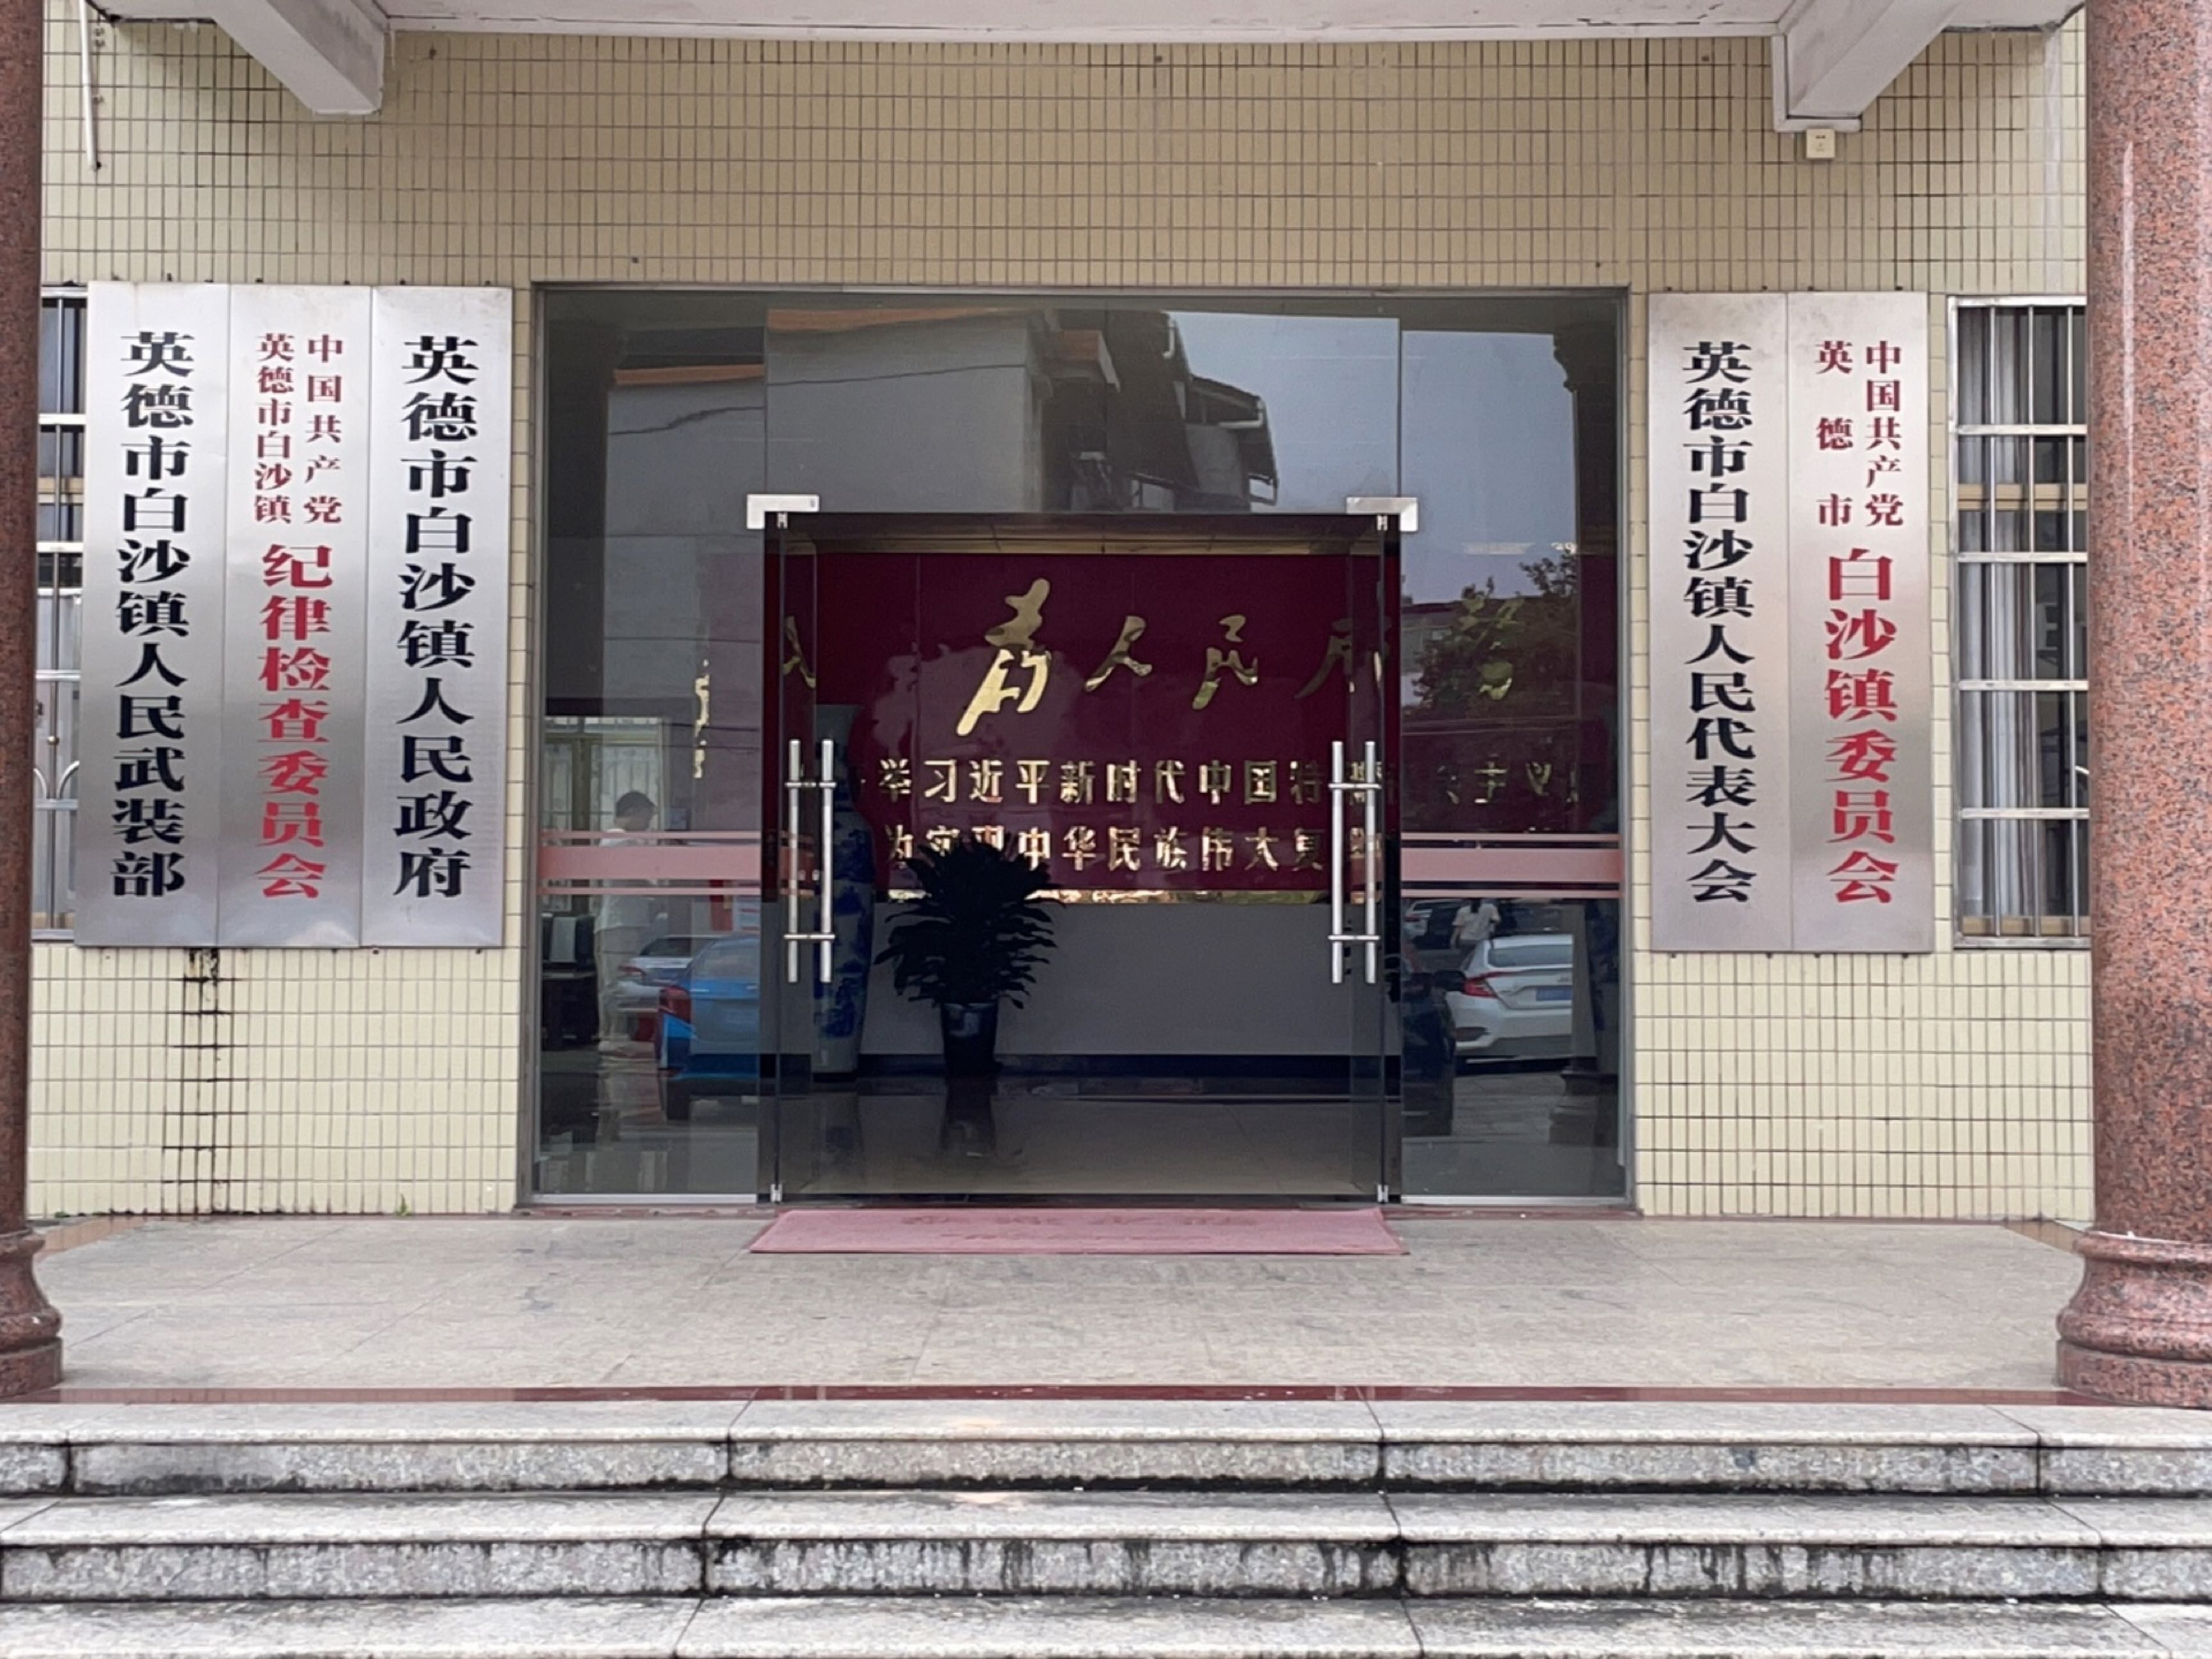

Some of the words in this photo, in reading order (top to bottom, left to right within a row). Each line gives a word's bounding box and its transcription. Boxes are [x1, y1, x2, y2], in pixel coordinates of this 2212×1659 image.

[254, 333, 295, 525] 英德市白沙镇
[304, 334, 344, 524] 中国共产党
[1816, 340, 1854, 527] 英德市
[1865, 340, 1905, 527] 中国共产党
[111, 330, 195, 898] 英德市白沙镇人民武装部
[256, 543, 334, 899] 纪律检查委员会
[393, 335, 479, 898] 英德市白沙镇人民政府
[1682, 341, 1758, 904] 英德市白沙镇人民代表大会
[1824, 547, 1899, 904] 白沙镇委员会
